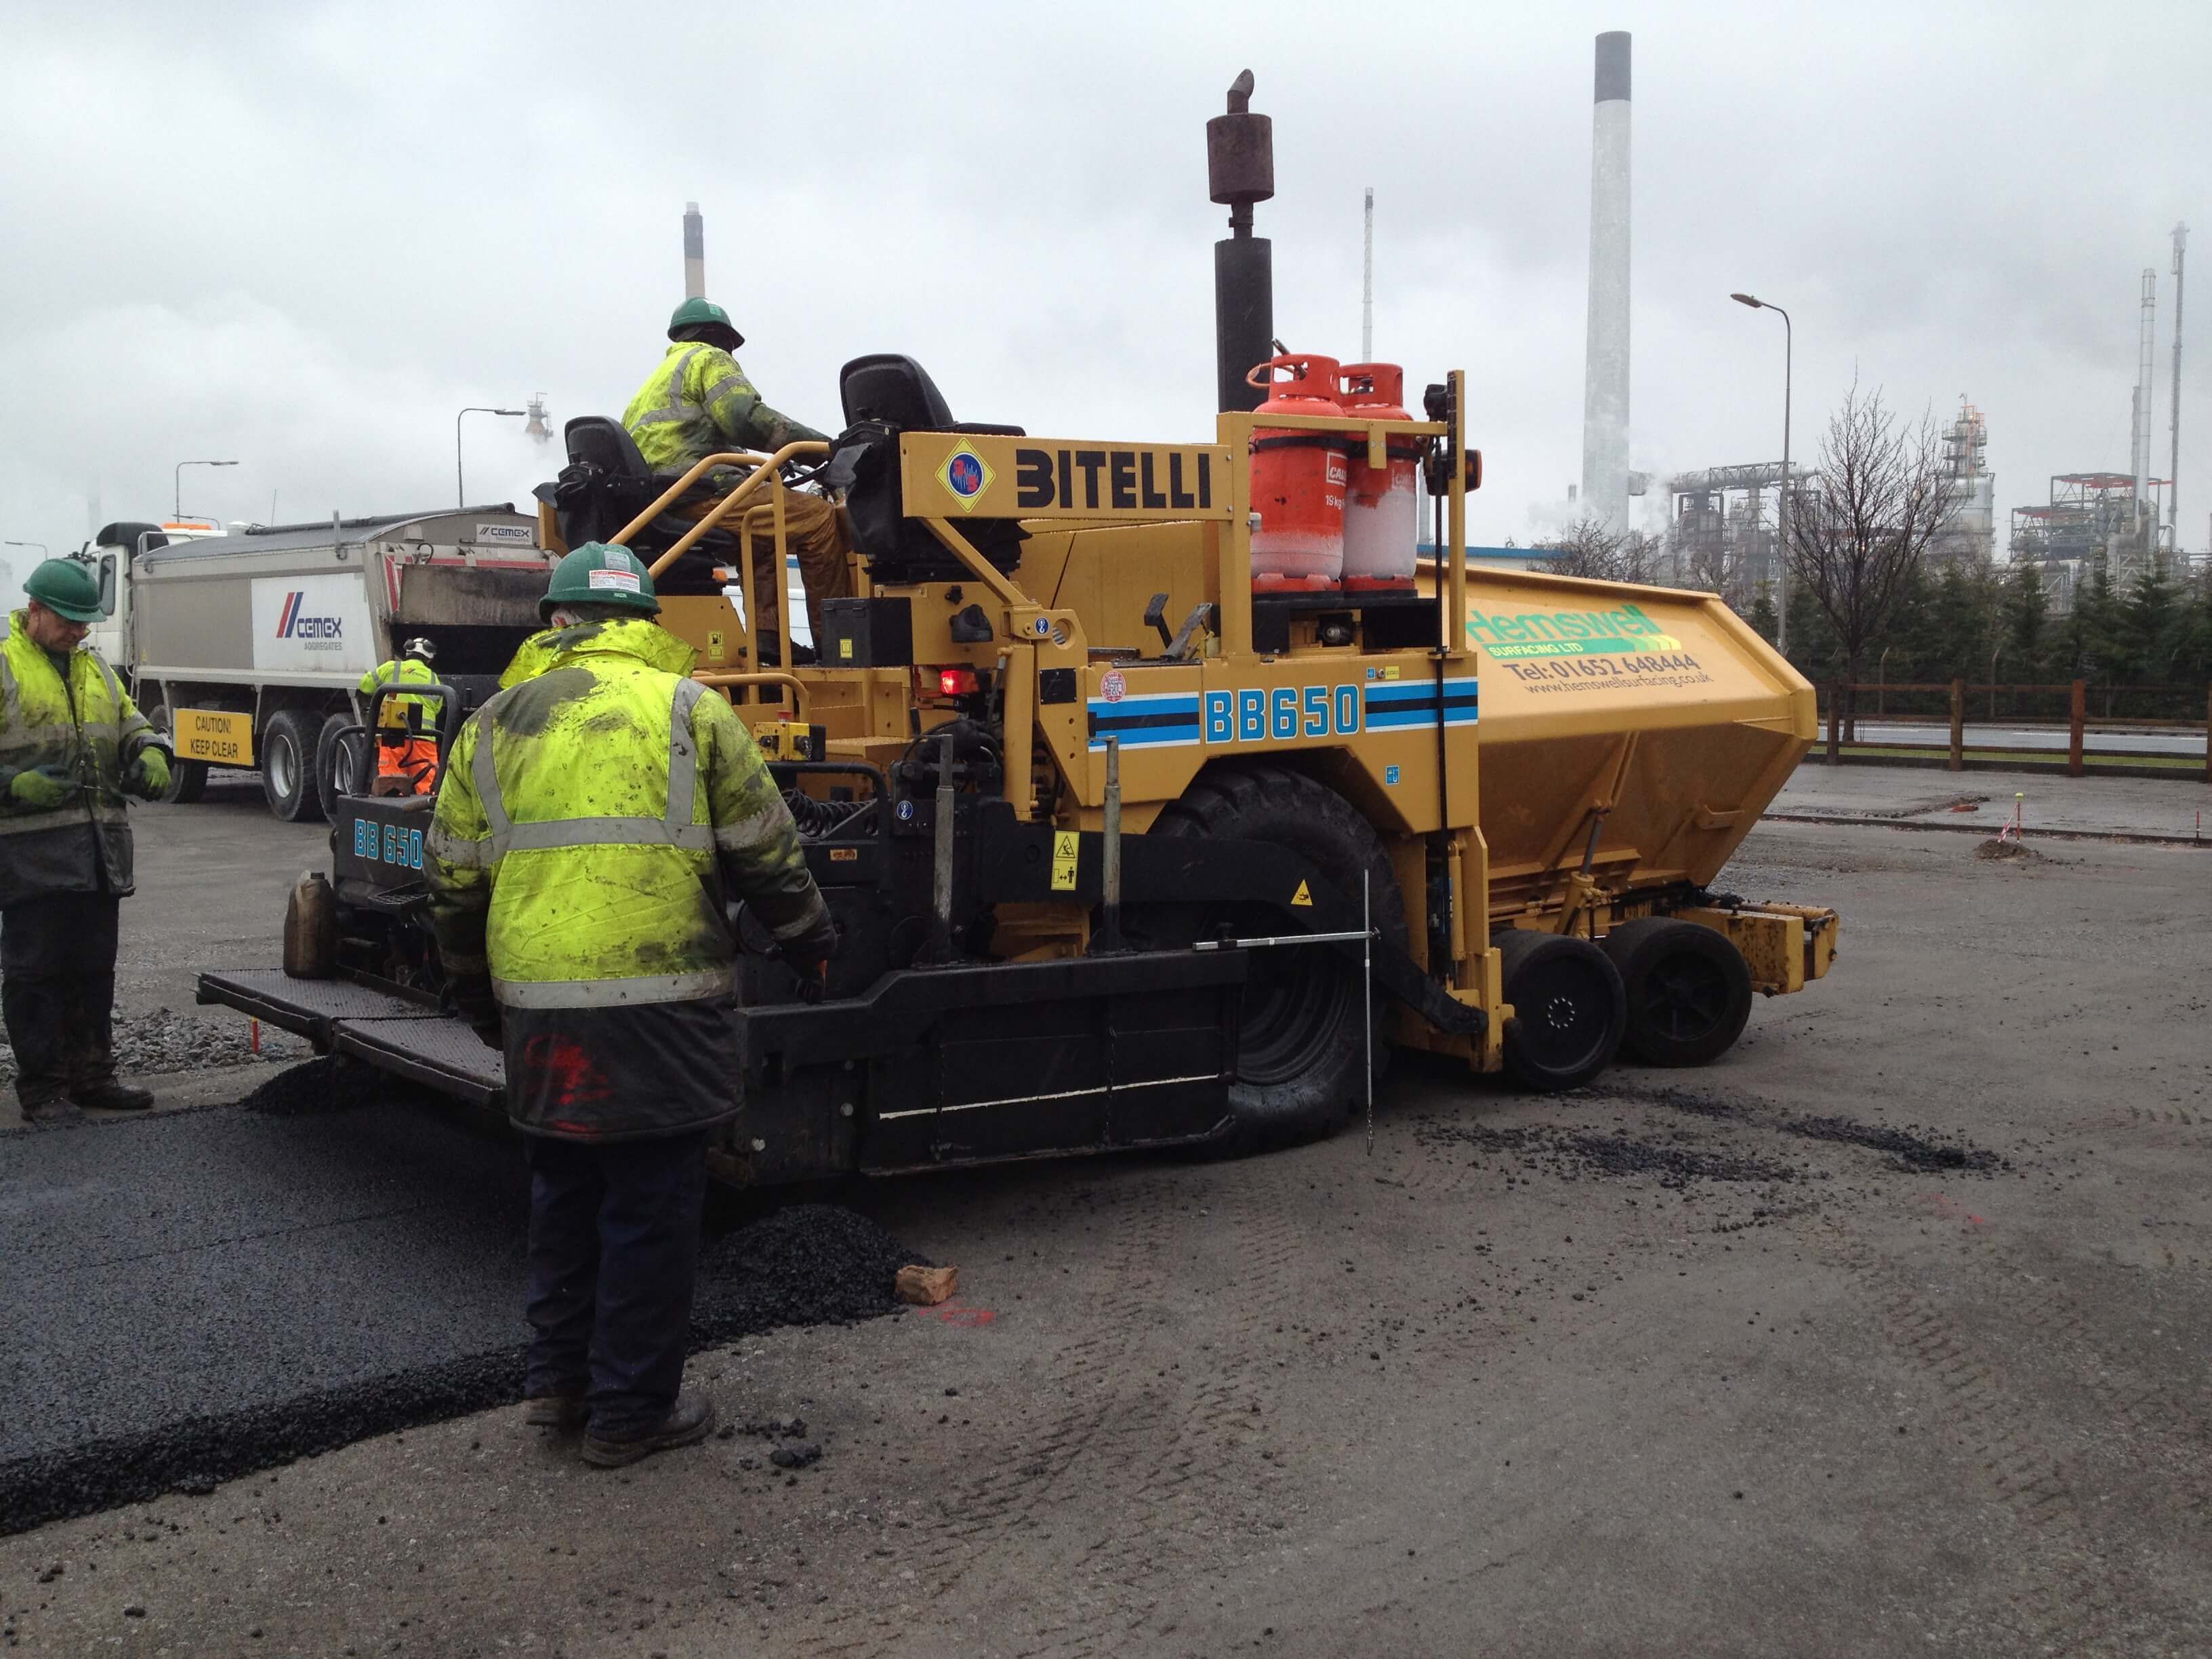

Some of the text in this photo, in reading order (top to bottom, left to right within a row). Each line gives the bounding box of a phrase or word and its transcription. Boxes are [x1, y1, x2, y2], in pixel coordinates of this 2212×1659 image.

[1016, 449, 1212, 509] BITELLI
[491, 528, 529, 537] CEMEX
[297, 617, 342, 638] CEMEX
[1465, 603, 1663, 642] Hemswell
[304, 641, 342, 651] AGGREGATES
[1489, 643, 1584, 657] SURFACING LTD
[1622, 653, 1702, 673] 648444
[1524, 671, 1714, 693] www.hemswellsurfacing.co.uk
[1204, 684, 1359, 744] BB650
[195, 715, 232, 734] CAUTION!
[190, 738, 239, 758] KEEP CLEAR
[354, 818, 423, 870] BB 650
